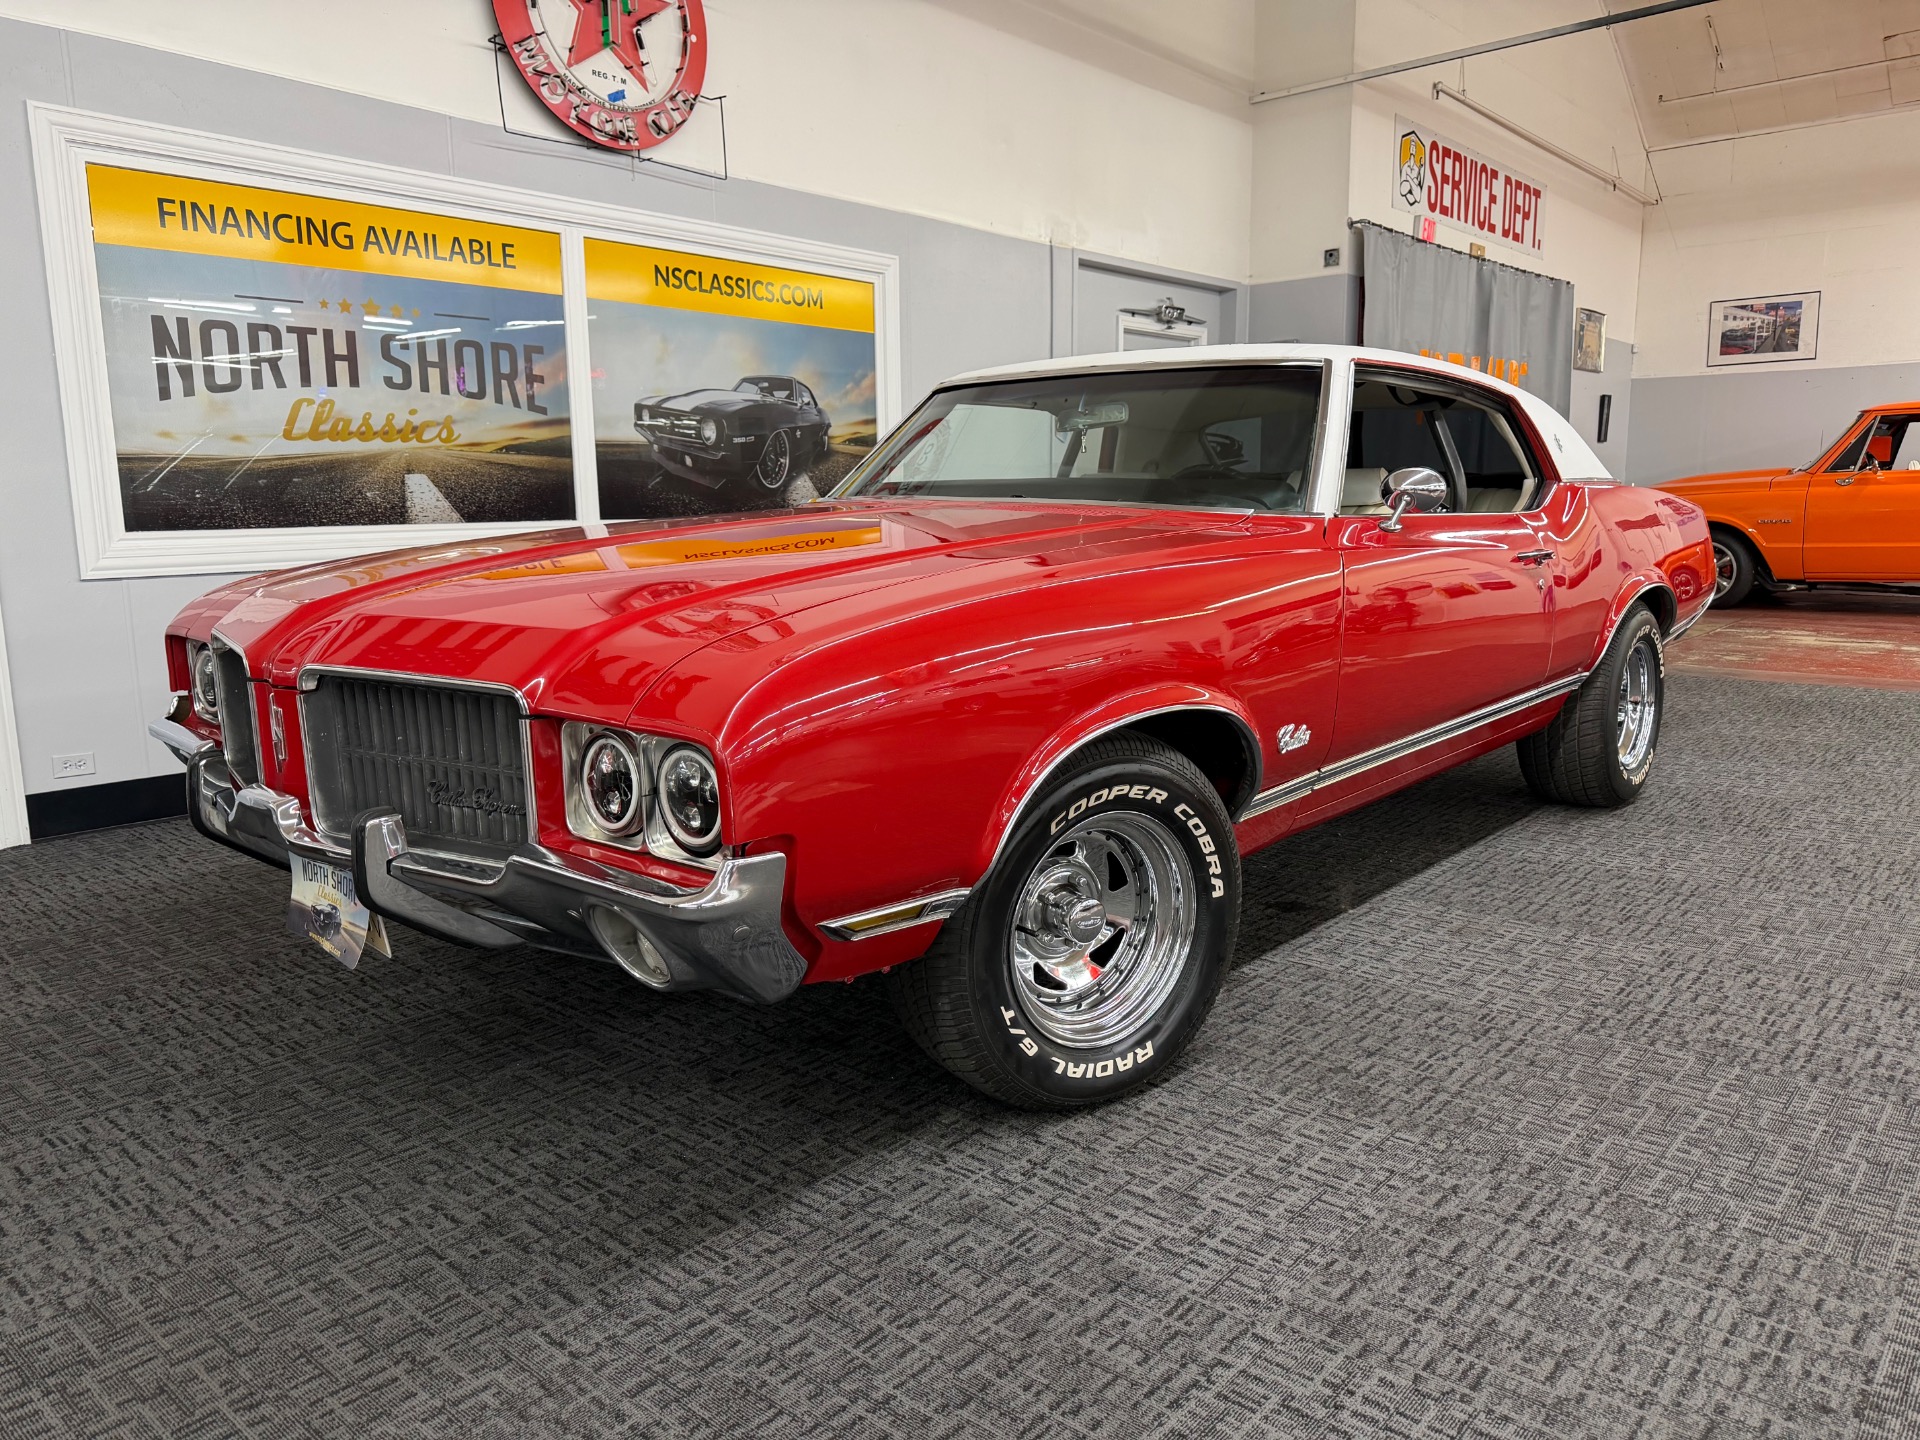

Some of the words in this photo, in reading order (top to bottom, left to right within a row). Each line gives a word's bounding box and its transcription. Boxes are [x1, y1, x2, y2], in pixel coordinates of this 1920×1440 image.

[582, 90, 591, 99] BY
[594, 98, 606, 108] THE
[1427, 140, 1499, 234] SERVICE
[1501, 174, 1542, 251] DEPT.
[156, 197, 354, 250] FINANCING
[362, 225, 517, 270] AVAILABLE
[653, 264, 824, 309] NSCLASSICS.COM
[150, 313, 360, 401] NORTH
[380, 332, 549, 416] SHORE
[282, 397, 463, 445] Classics
[1629, 748, 1654, 785] RADIAL
[1050, 784, 1168, 836] COOPER
[1174, 803, 1225, 898] COBRA
[301, 858, 329, 886] NORTH
[317, 885, 342, 907] Classics
[1000, 1006, 1039, 1057] G/T
[1049, 1040, 1155, 1079] RADIAL
